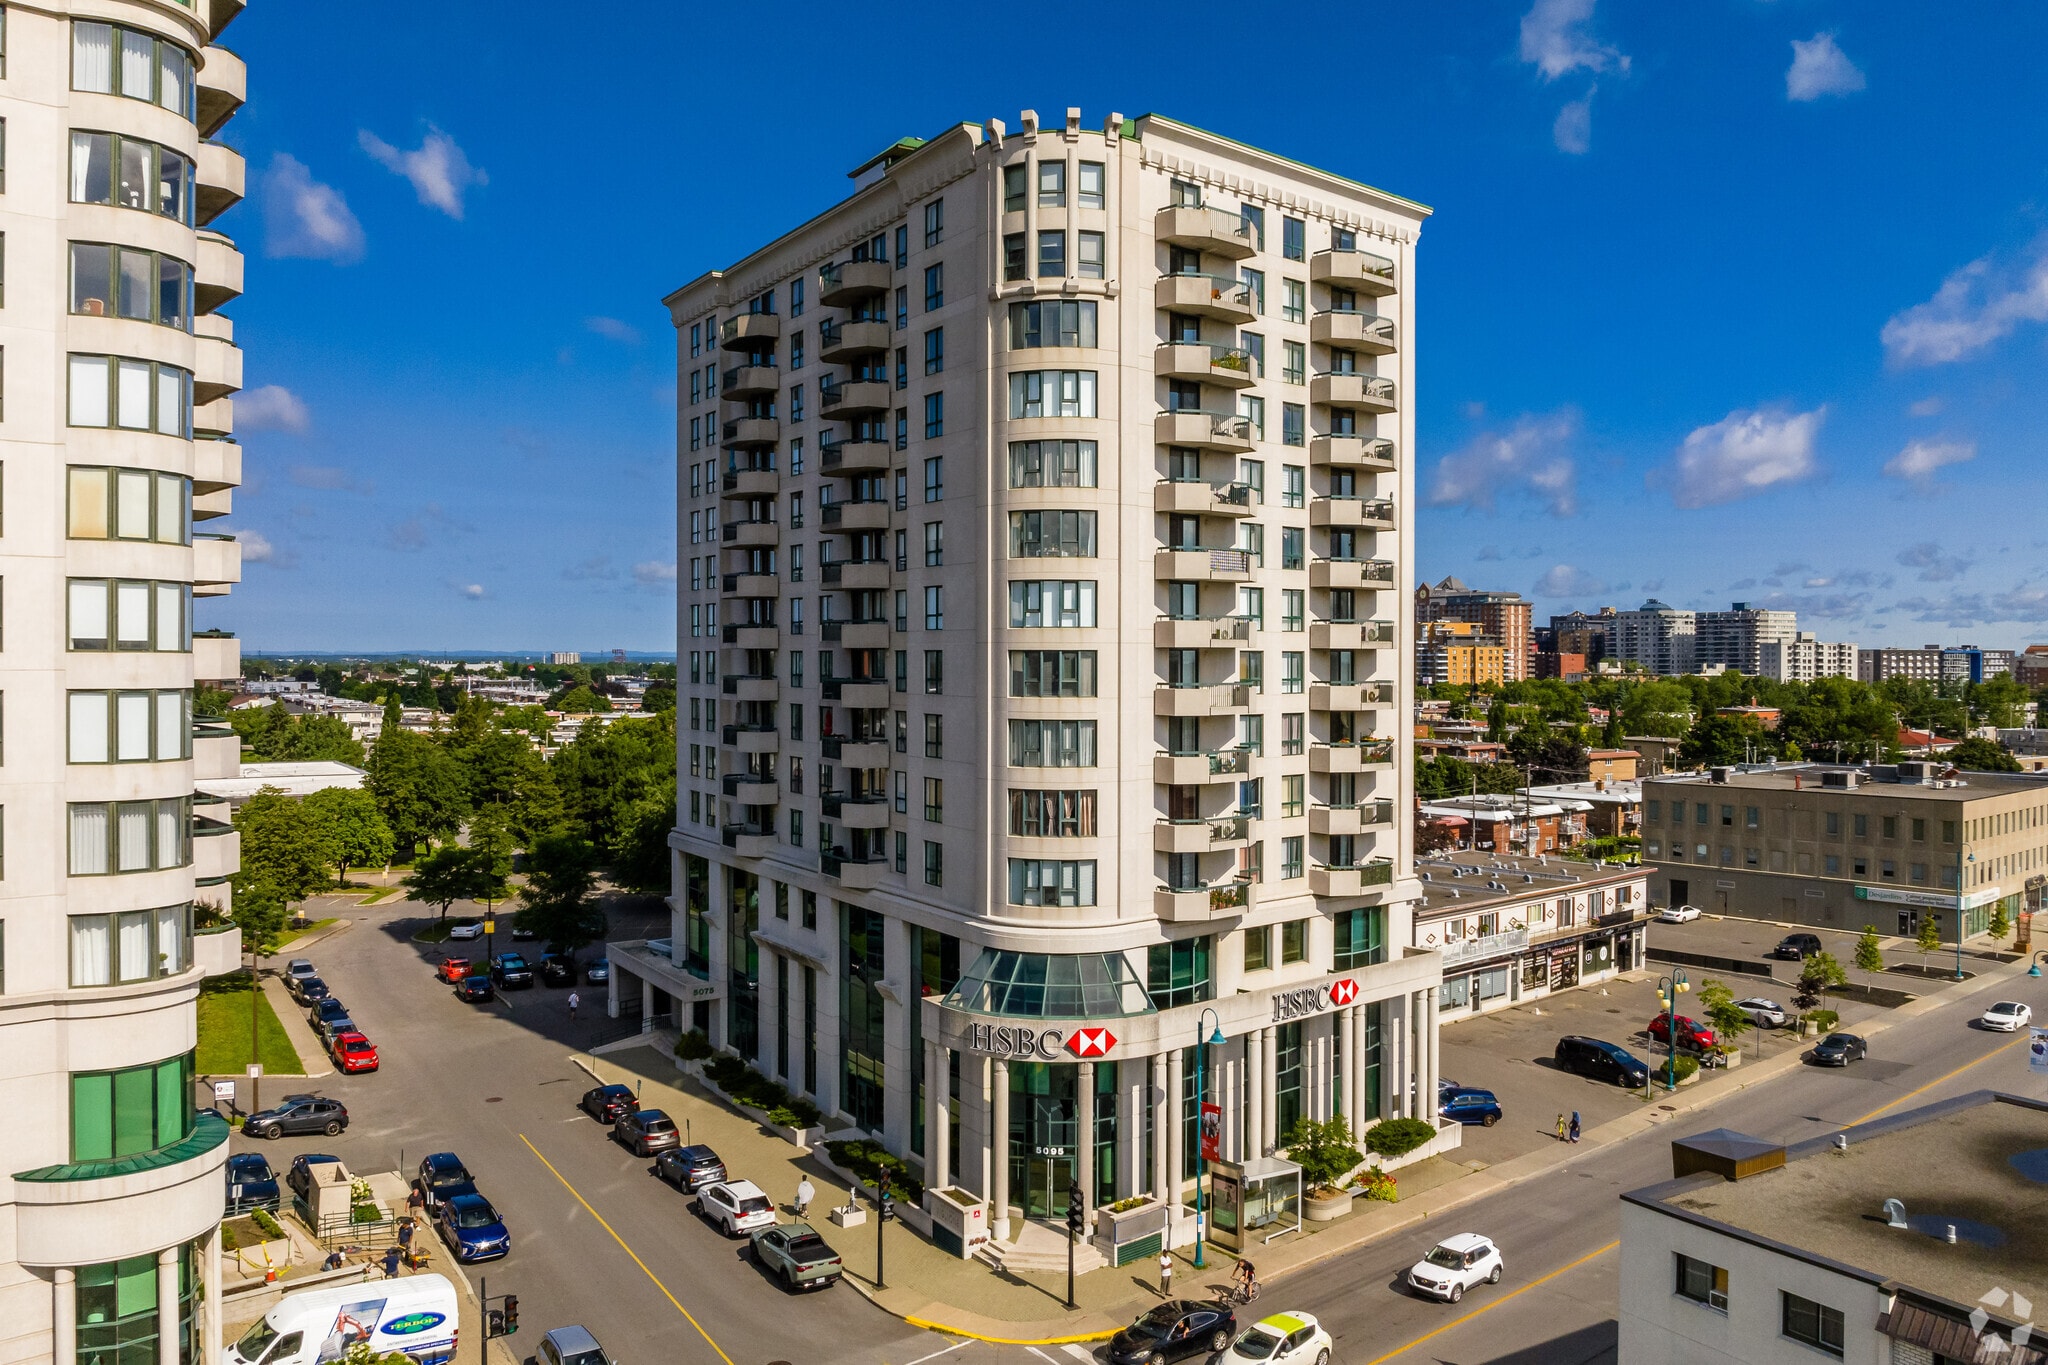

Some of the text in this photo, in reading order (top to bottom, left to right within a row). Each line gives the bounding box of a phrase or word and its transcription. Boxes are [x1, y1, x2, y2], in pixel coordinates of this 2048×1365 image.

[693, 987, 715, 996] 5075
[1272, 983, 1330, 1022] HSBC
[970, 1022, 1063, 1058] HSBC
[1035, 1146, 1064, 1156] 5095
